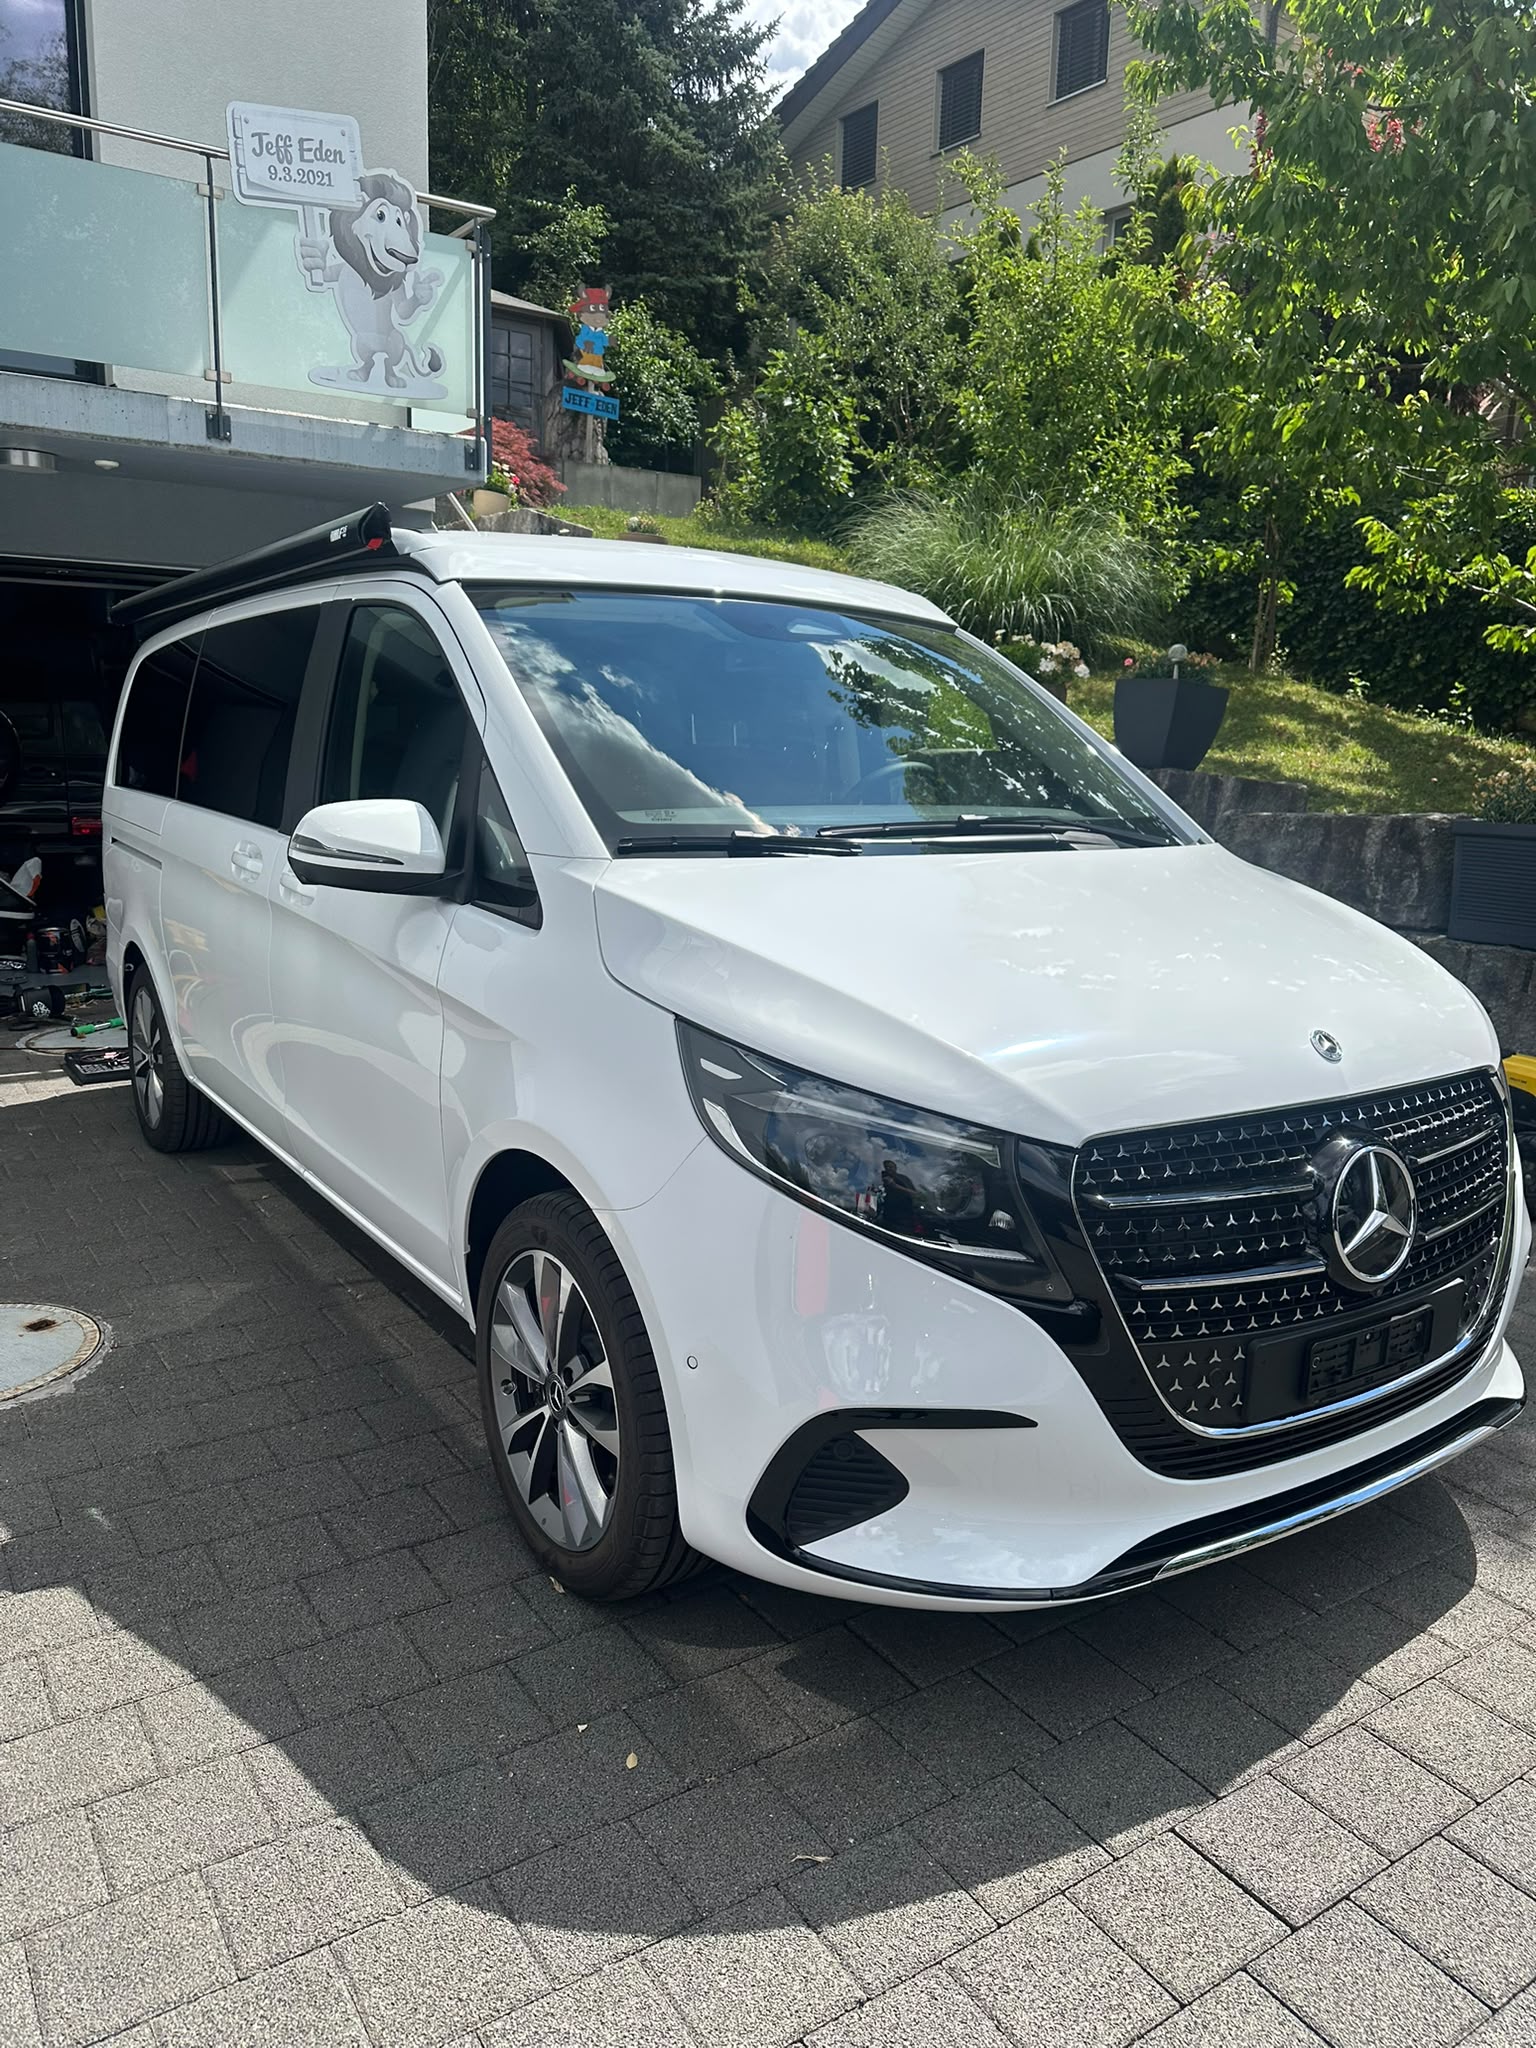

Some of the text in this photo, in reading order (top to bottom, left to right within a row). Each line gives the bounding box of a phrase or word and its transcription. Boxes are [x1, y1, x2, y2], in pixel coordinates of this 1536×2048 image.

[251, 132, 346, 165] Jeff Eden
[268, 164, 335, 187] 9.3.2021
[564, 393, 618, 415] JEFF EDEN
